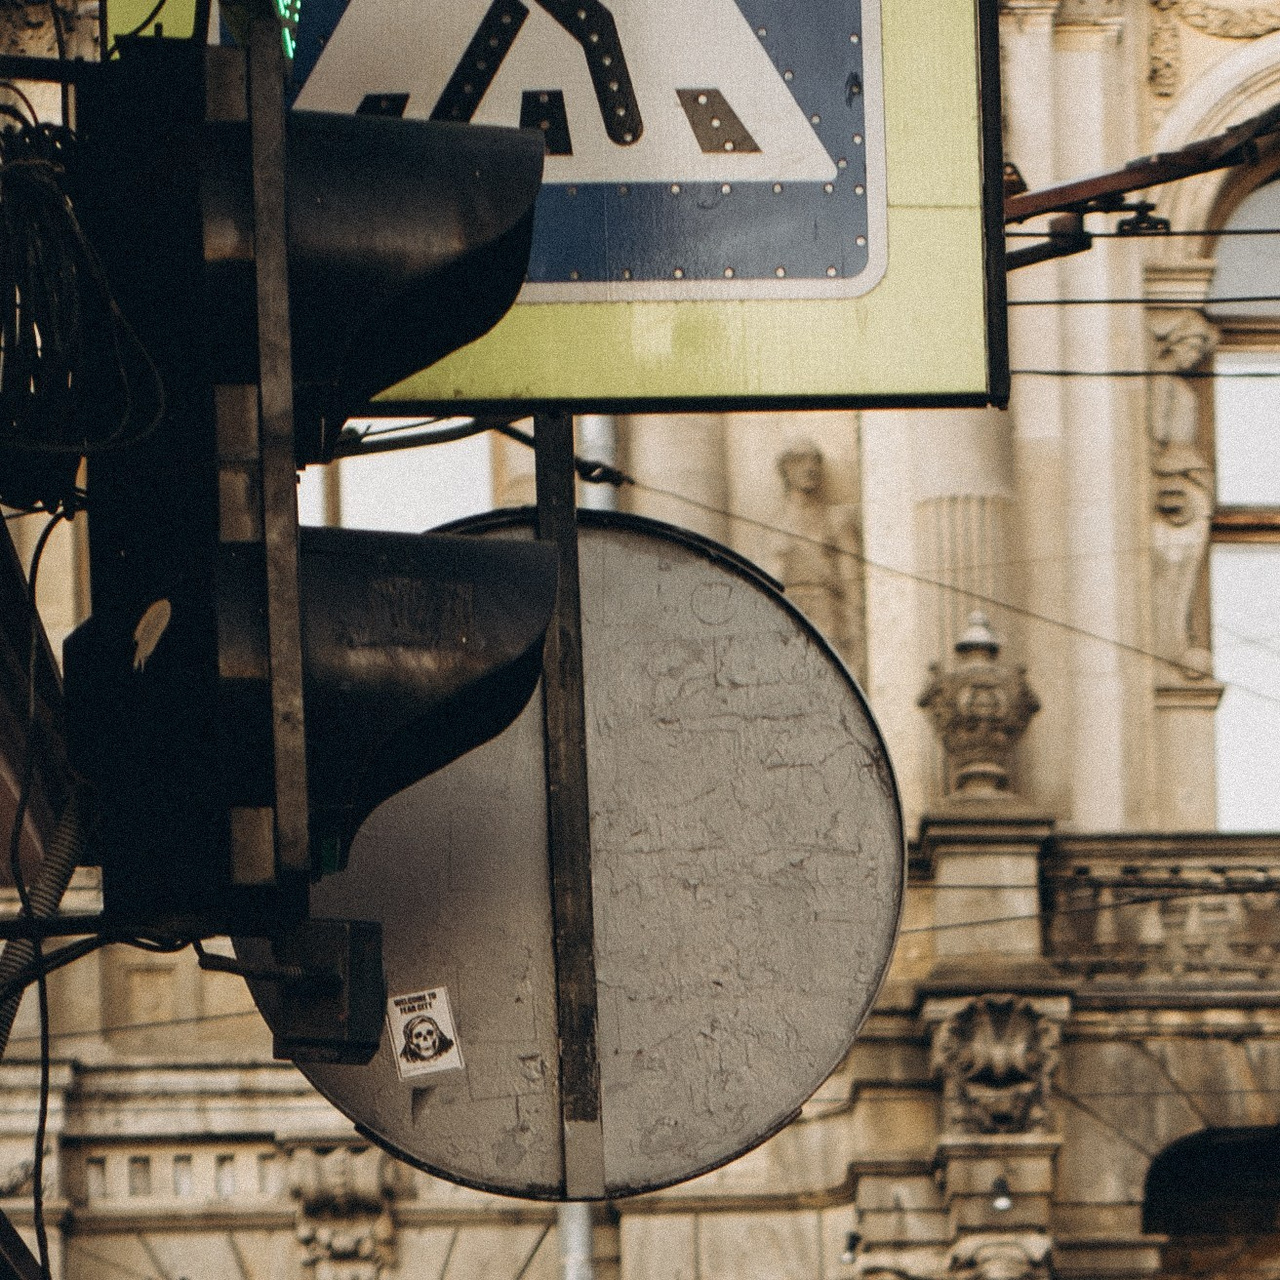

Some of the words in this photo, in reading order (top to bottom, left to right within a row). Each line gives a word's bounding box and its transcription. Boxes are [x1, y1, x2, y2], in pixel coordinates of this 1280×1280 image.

[394, 994, 426, 1006] WELCOME
[428, 992, 437, 1000] TO
[417, 1002, 432, 1011] CITY
